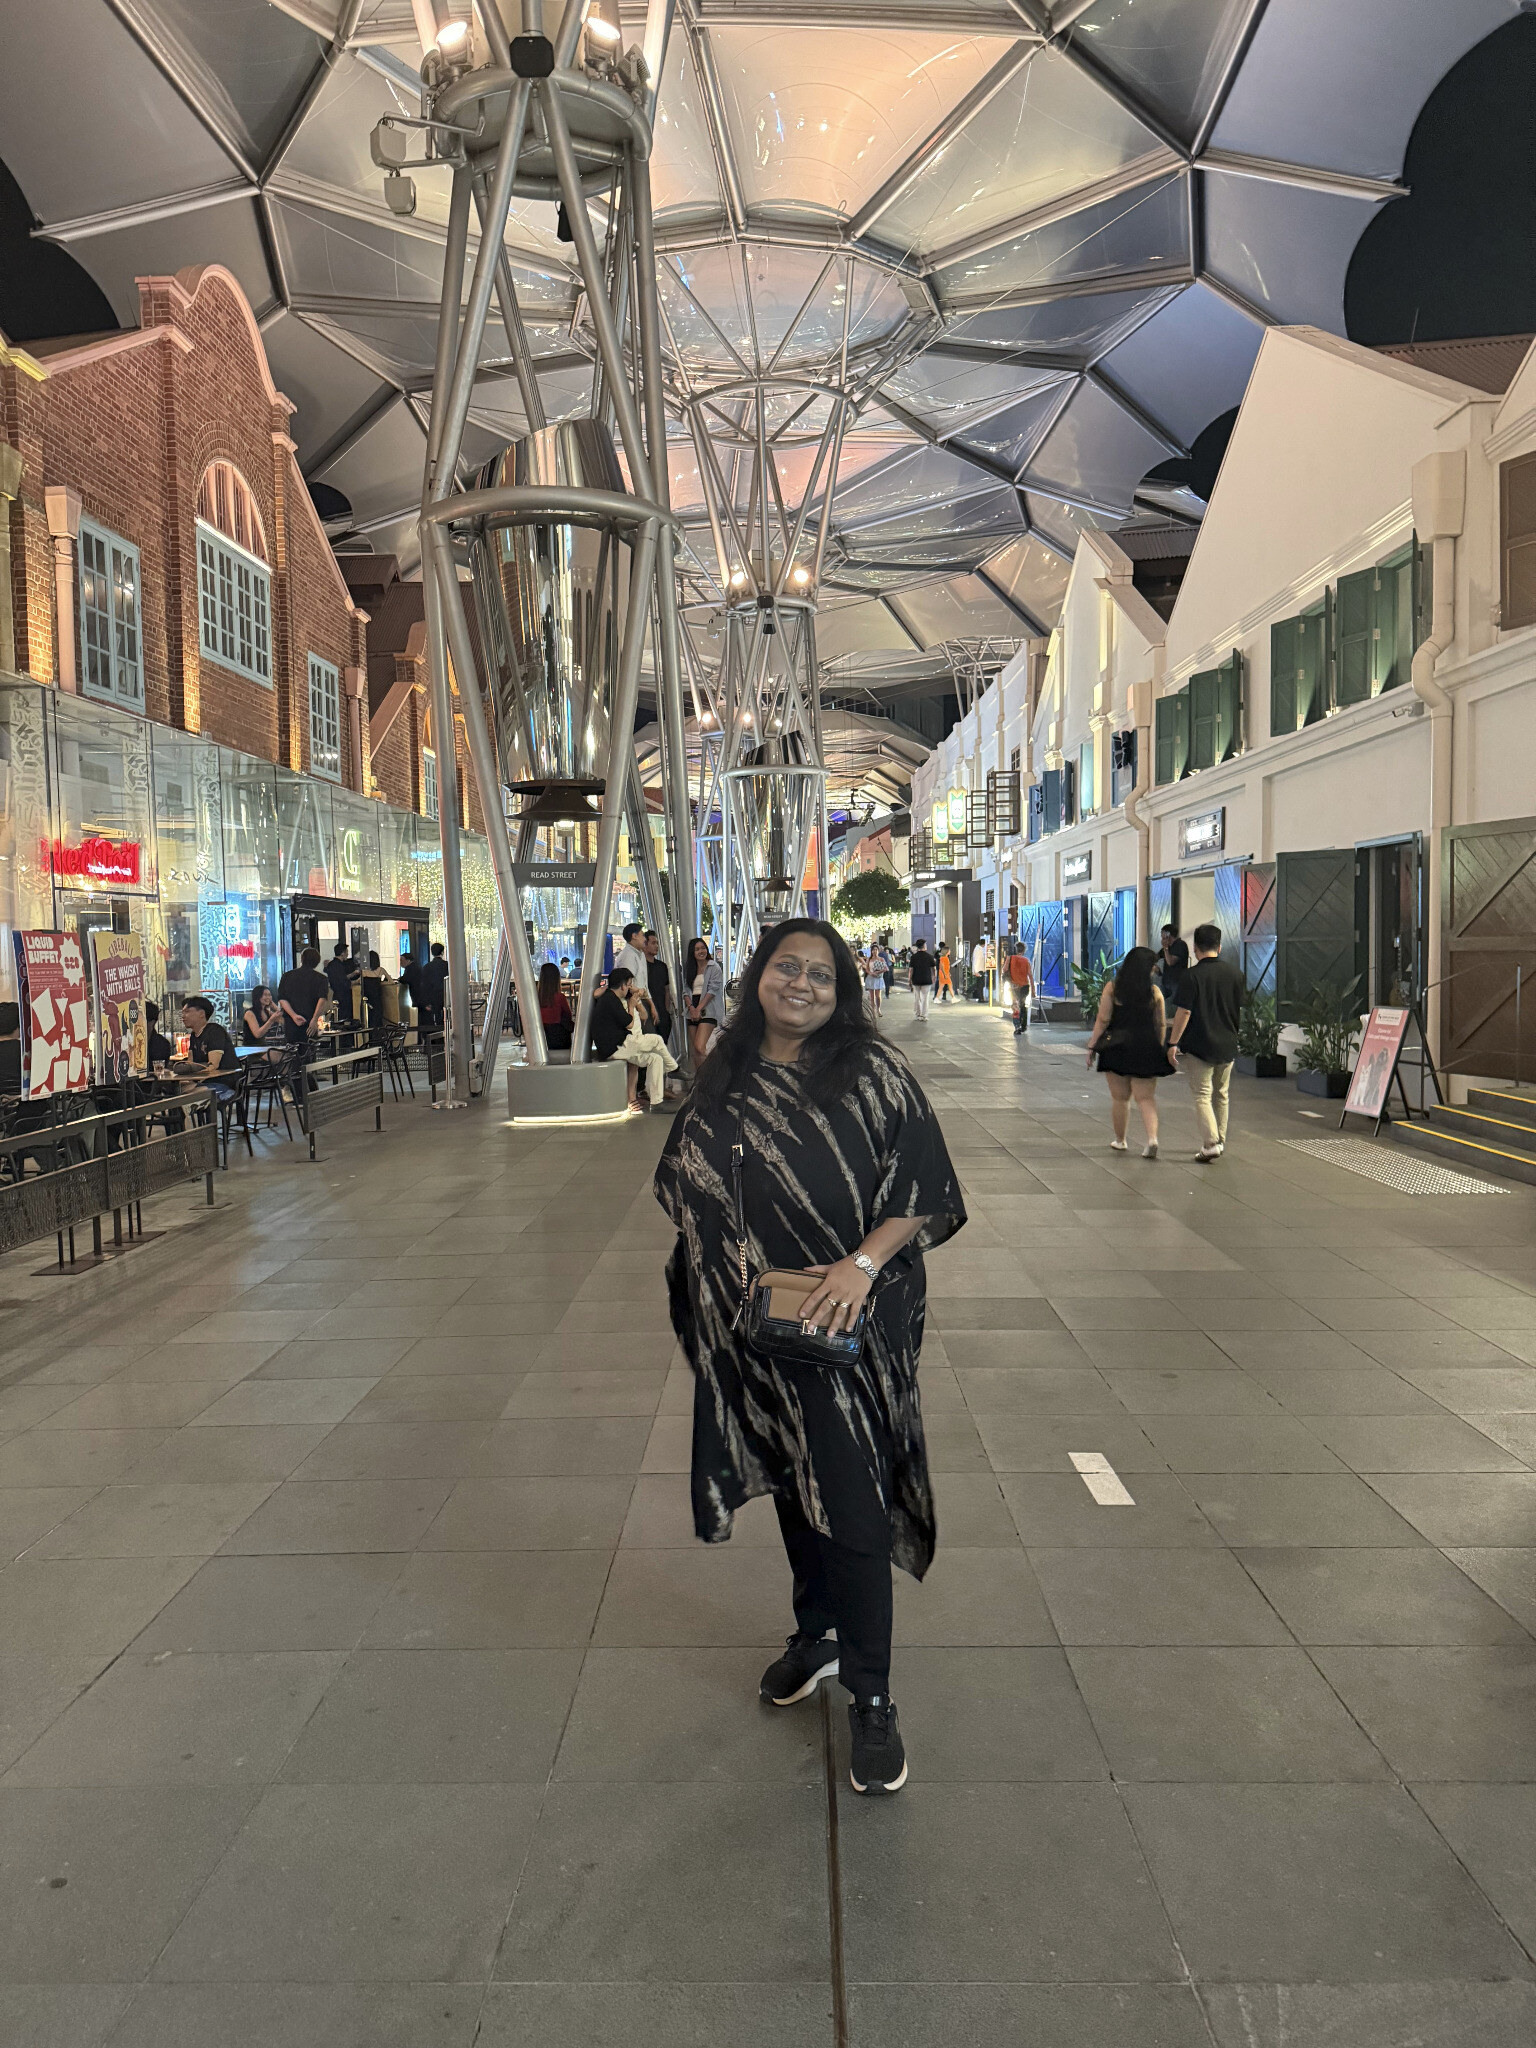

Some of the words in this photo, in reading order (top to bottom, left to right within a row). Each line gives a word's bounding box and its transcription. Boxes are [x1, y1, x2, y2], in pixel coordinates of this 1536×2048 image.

[25, 936, 54, 949] LIQUID
[108, 937, 134, 960] FIREBALL
[27, 950, 59, 963] BUFFET
[104, 967, 117, 982] THE
[117, 963, 139, 979] WHISKY
[106, 981, 123, 996] WITH
[123, 976, 141, 993] BALLS
